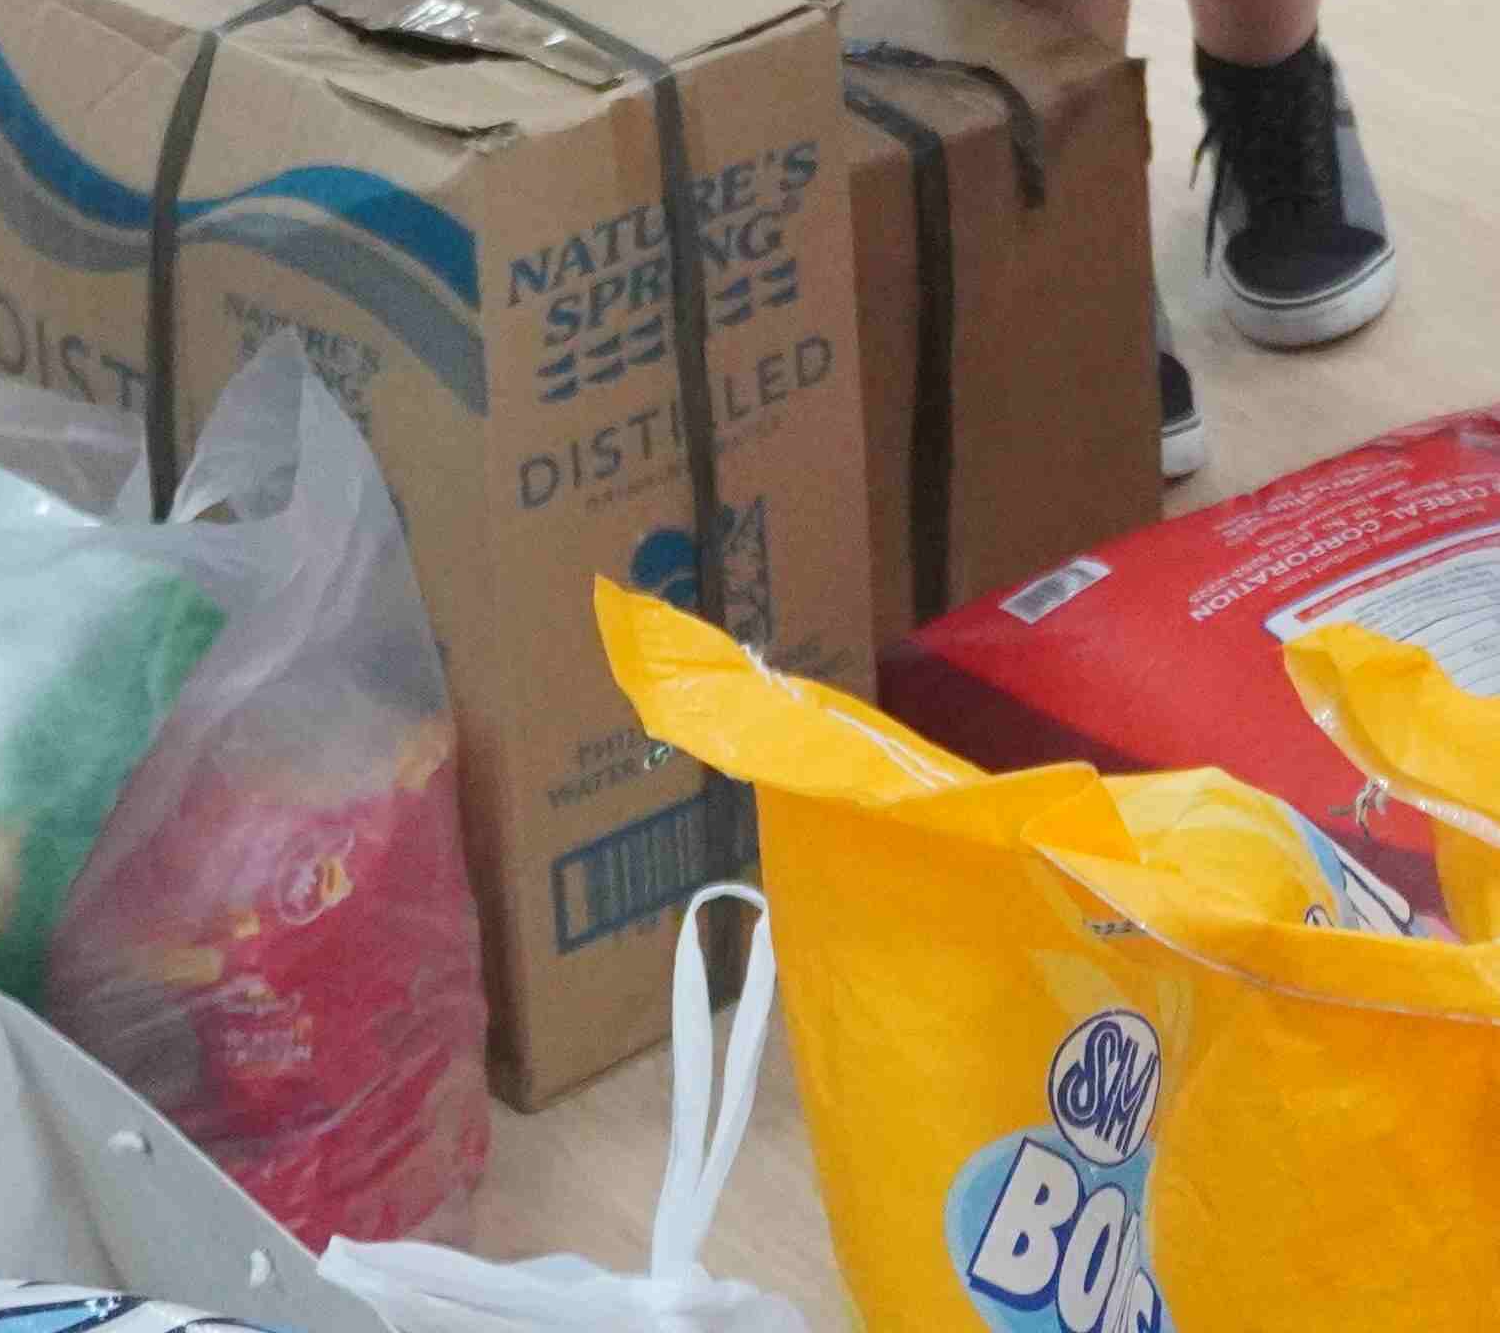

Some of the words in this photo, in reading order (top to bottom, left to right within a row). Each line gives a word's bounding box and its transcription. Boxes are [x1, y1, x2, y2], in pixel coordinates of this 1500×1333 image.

[544, 209, 784, 347] SPRNG
[517, 335, 832, 509] DISTILED
[1188, 517, 1381, 622] CORPORATION
[1384, 484, 1489, 521] CEREAL
[1056, 1019, 1158, 1156] SM
